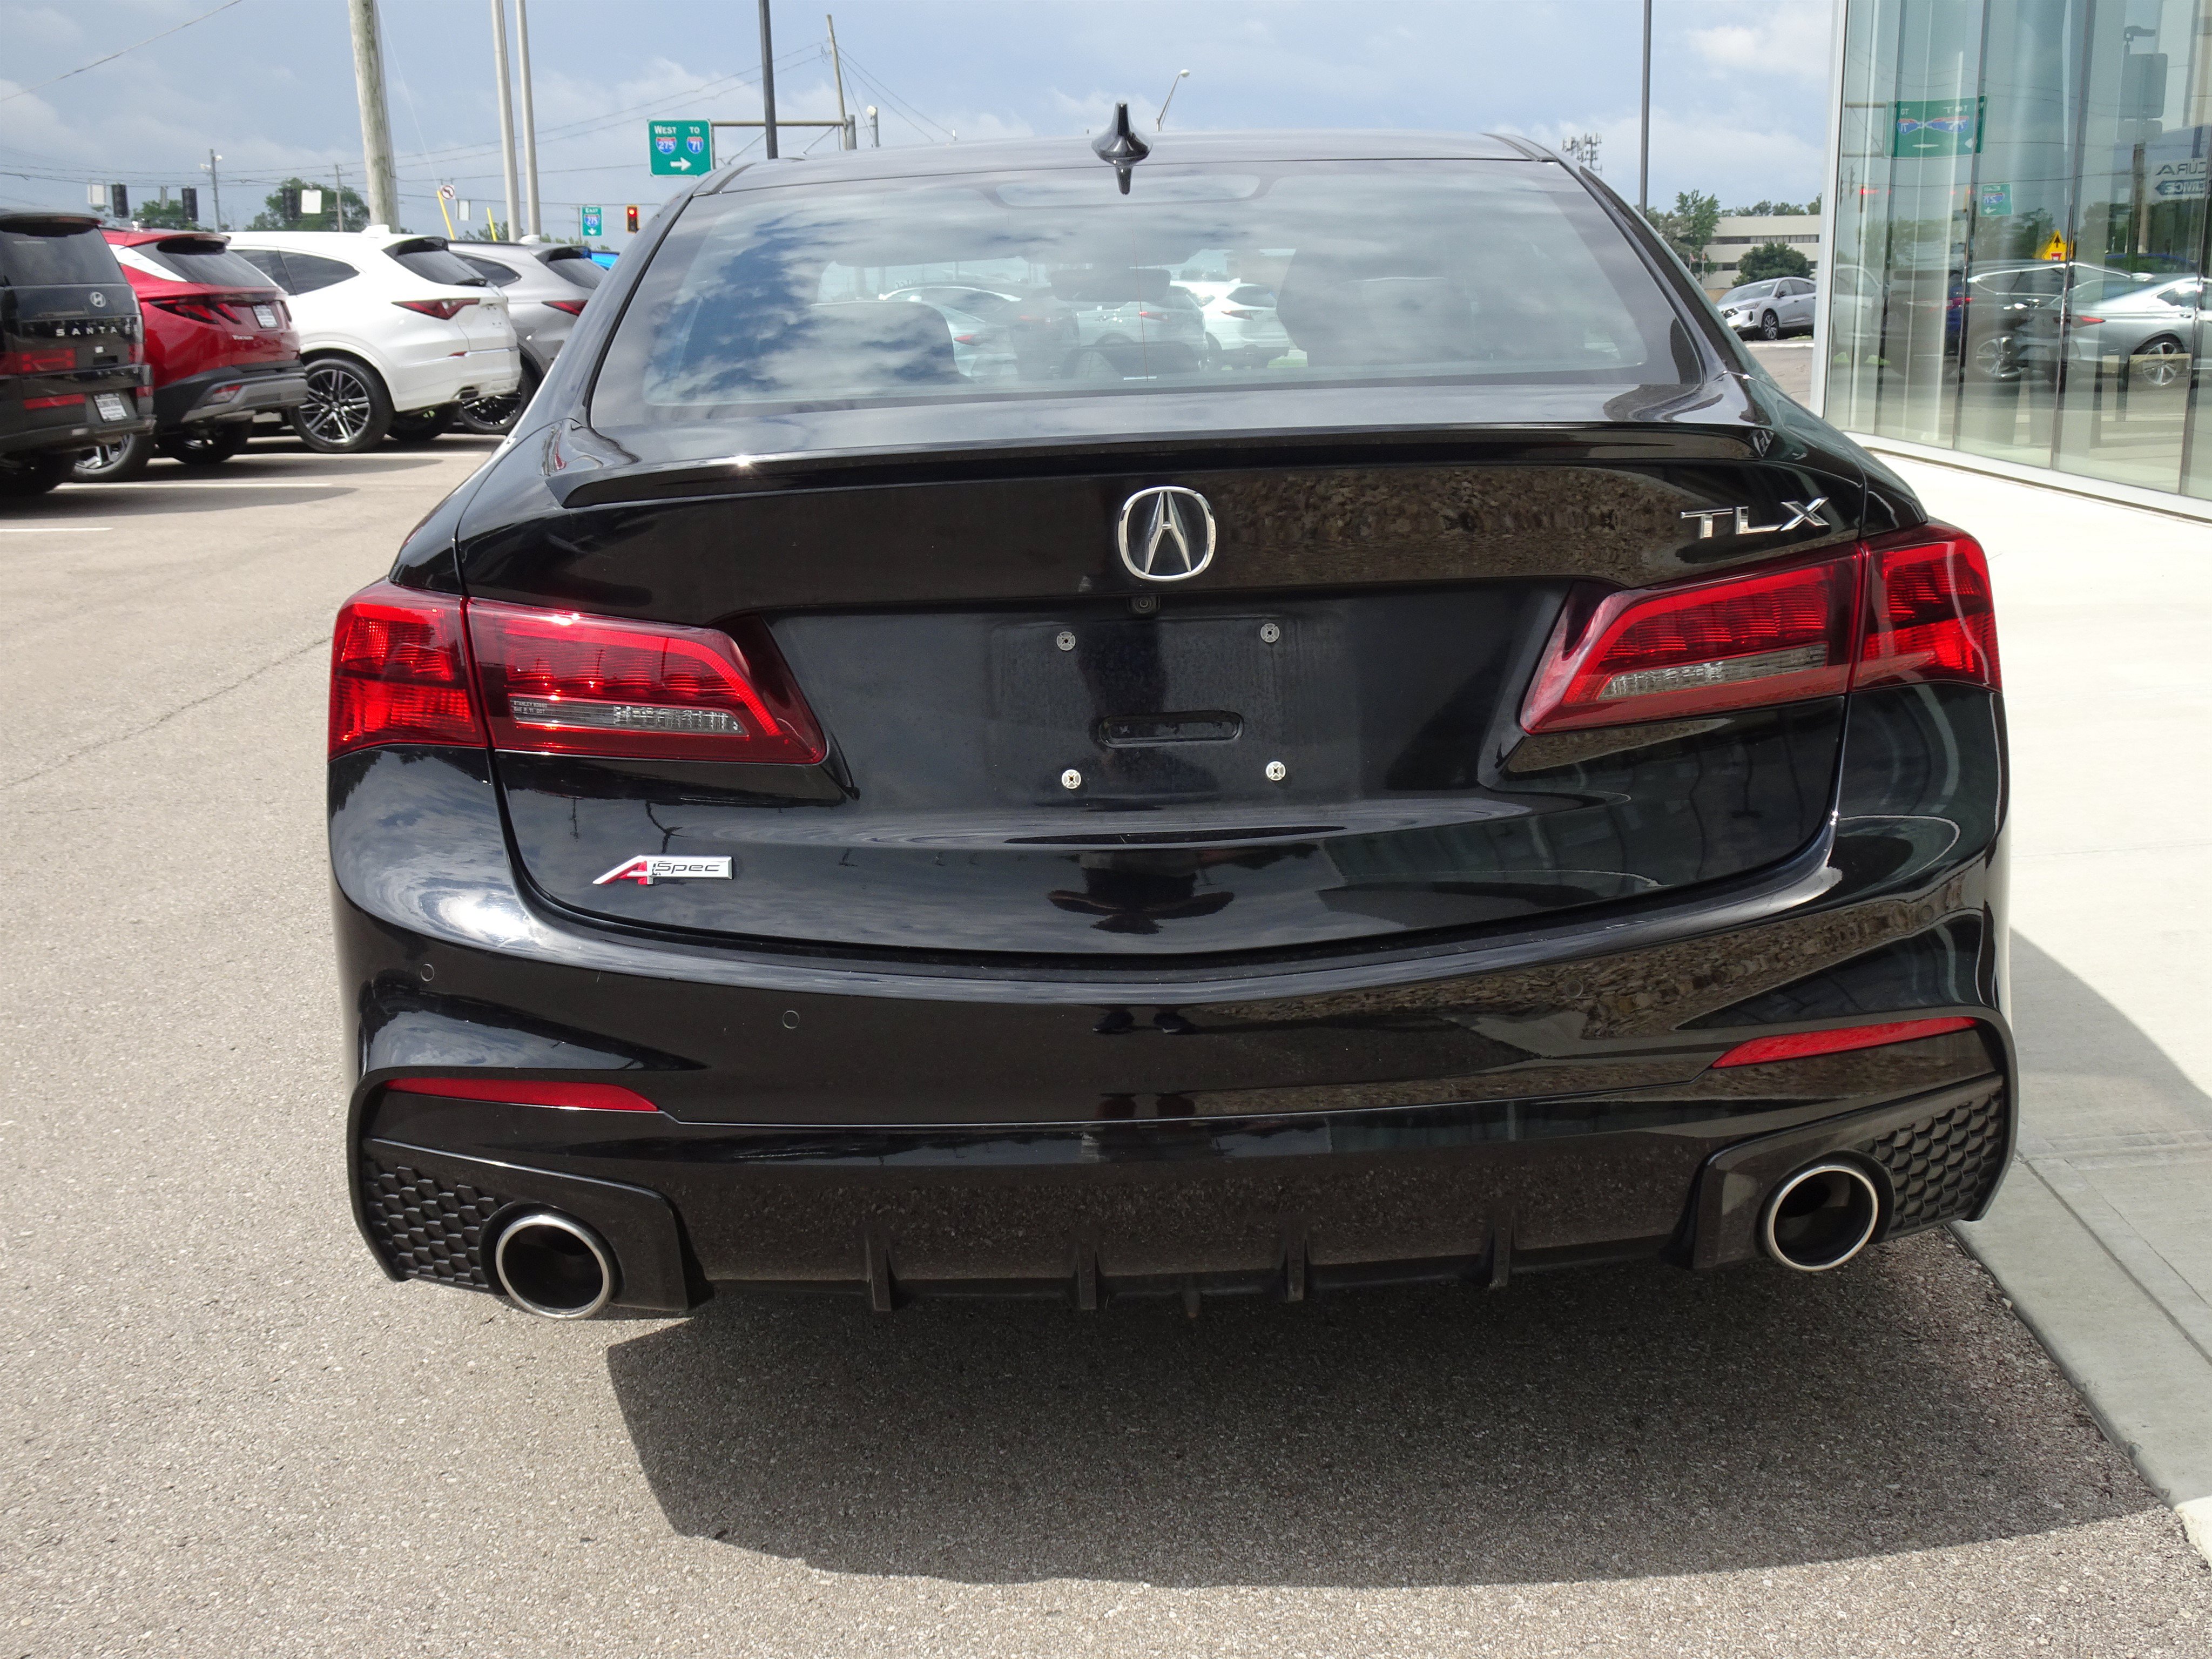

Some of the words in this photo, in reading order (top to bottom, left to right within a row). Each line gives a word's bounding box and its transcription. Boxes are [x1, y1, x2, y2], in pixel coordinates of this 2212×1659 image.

[689, 126, 700, 134] TO
[658, 141, 675, 150] 275
[690, 141, 701, 151] 71
[586, 217, 598, 226] 275
[56, 326, 118, 337] SANTA
[1680, 496, 1830, 539] TLX
